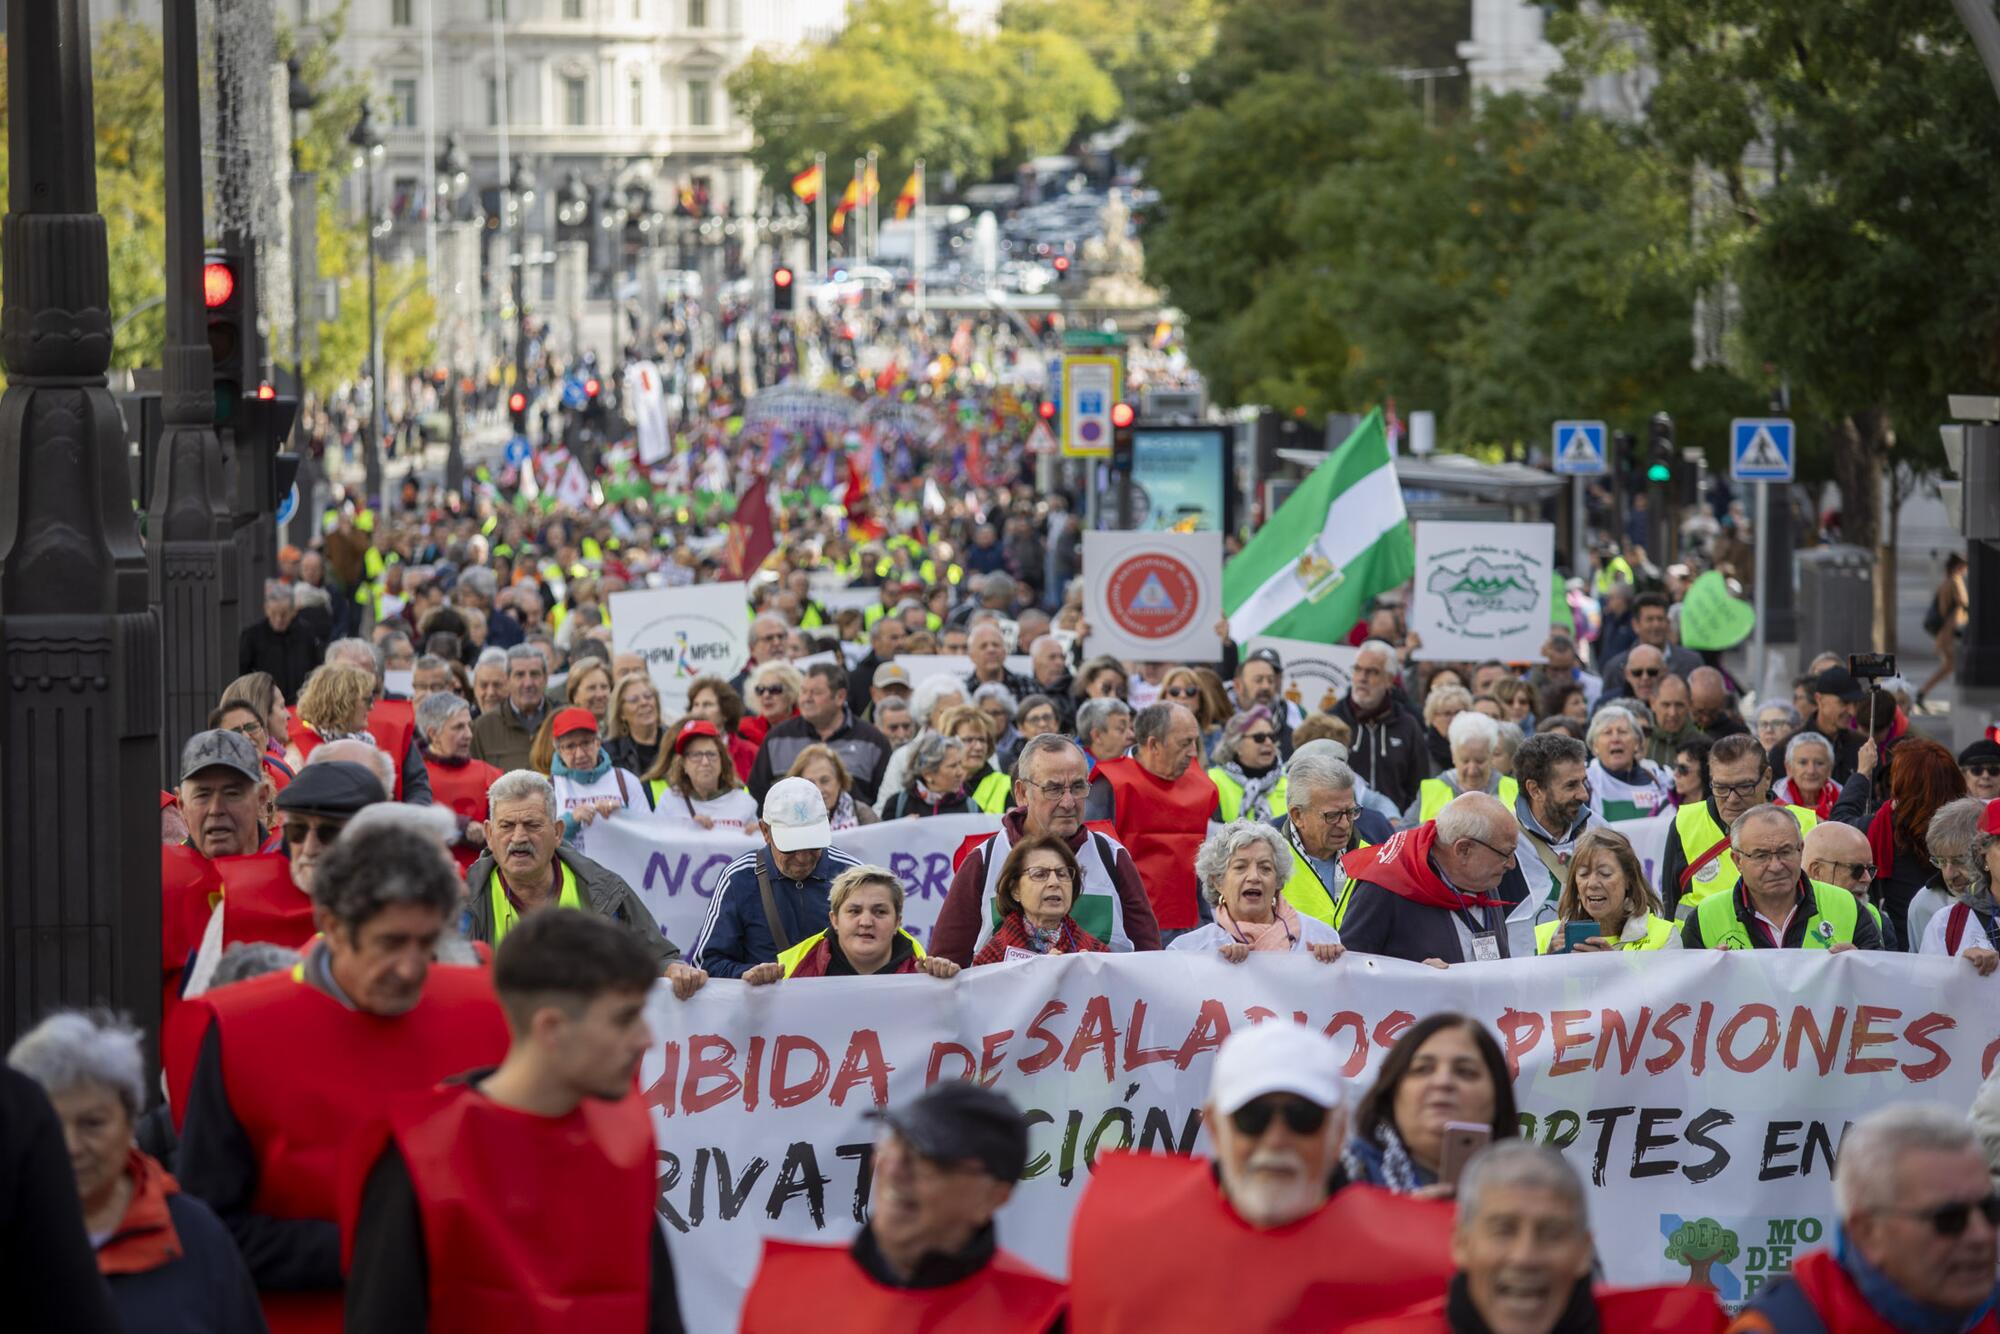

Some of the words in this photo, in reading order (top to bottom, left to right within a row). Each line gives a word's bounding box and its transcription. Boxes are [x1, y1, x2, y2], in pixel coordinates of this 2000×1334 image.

[640, 1028, 896, 1117] UBIDA
[926, 1029, 1014, 1090] DE
[1497, 1001, 1957, 1083] PENSIONES
[1766, 1217, 1823, 1245] MO
[1745, 1246, 1793, 1272] DE
